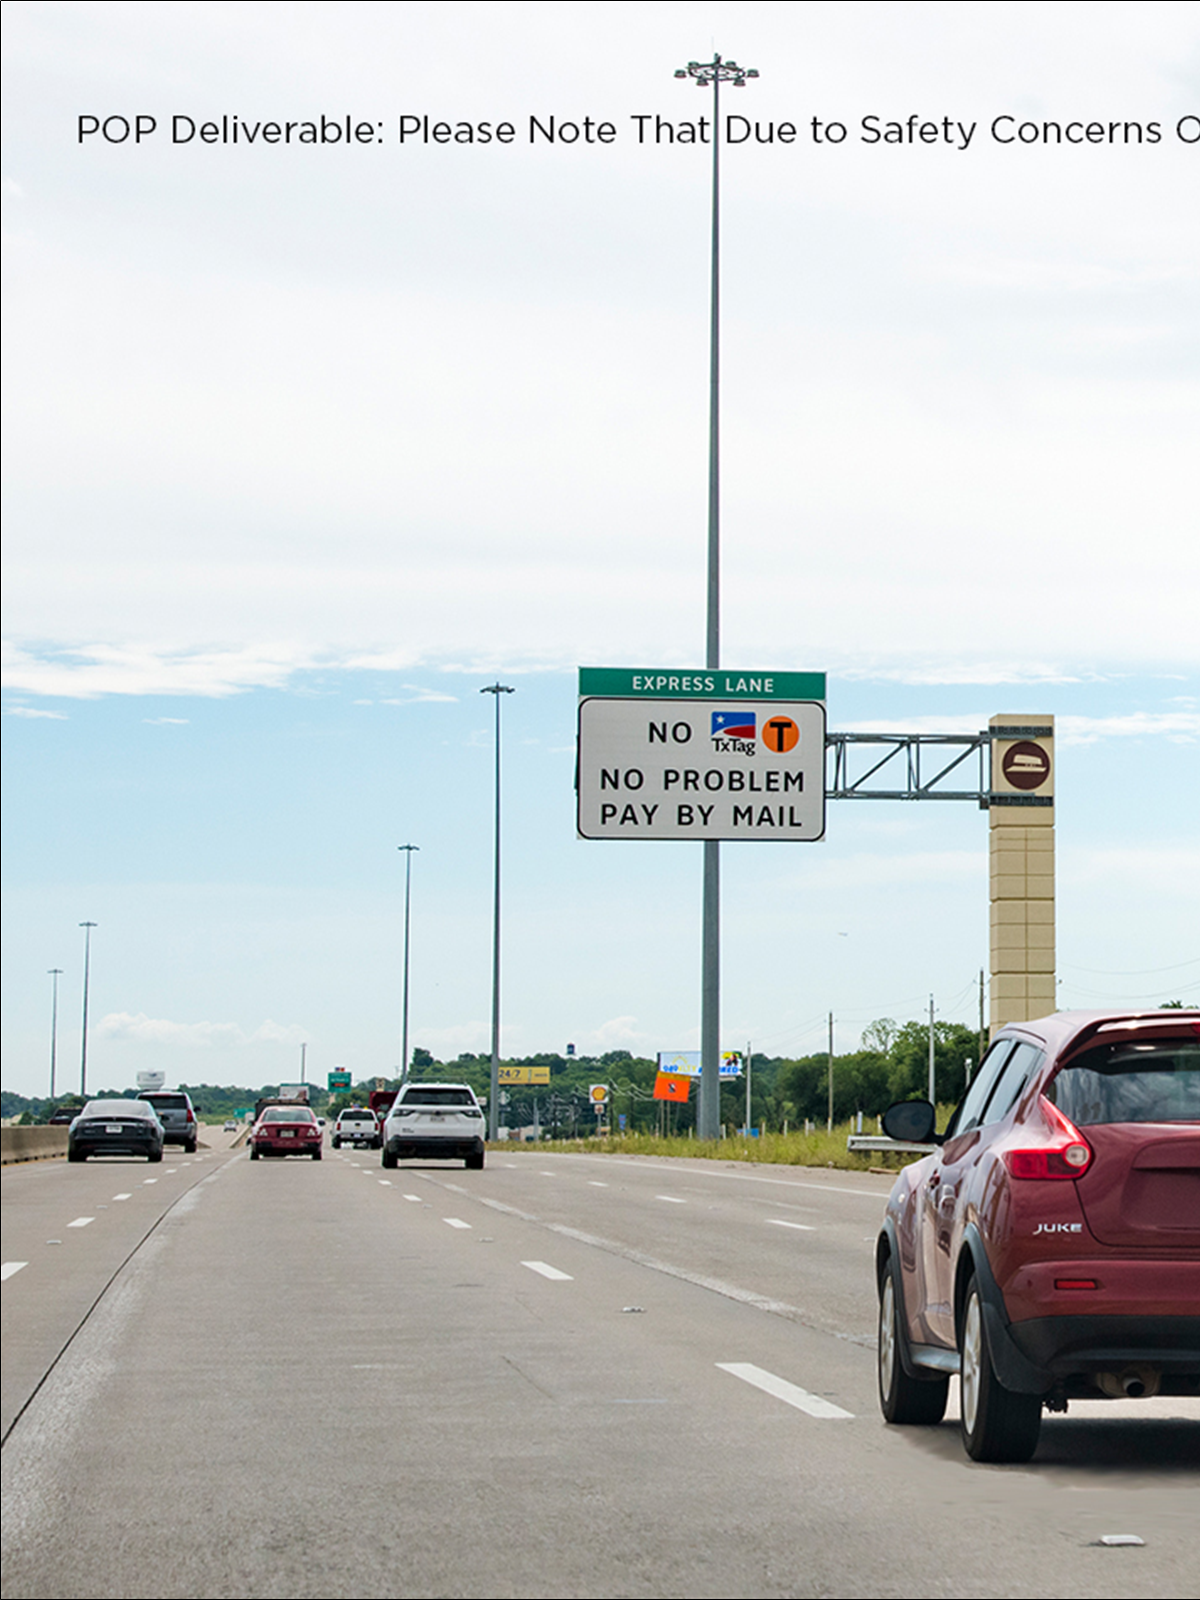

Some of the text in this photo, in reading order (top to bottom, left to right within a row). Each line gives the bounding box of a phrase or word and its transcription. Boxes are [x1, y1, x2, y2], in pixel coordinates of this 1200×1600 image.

[632, 676, 774, 693] EXPRESS LANE
[649, 721, 792, 757] NO TxTag T
[600, 768, 804, 793] NO PROBLEM
[601, 803, 802, 828] PAY BY MAIL
[1032, 1223, 1083, 1236] JUKE
